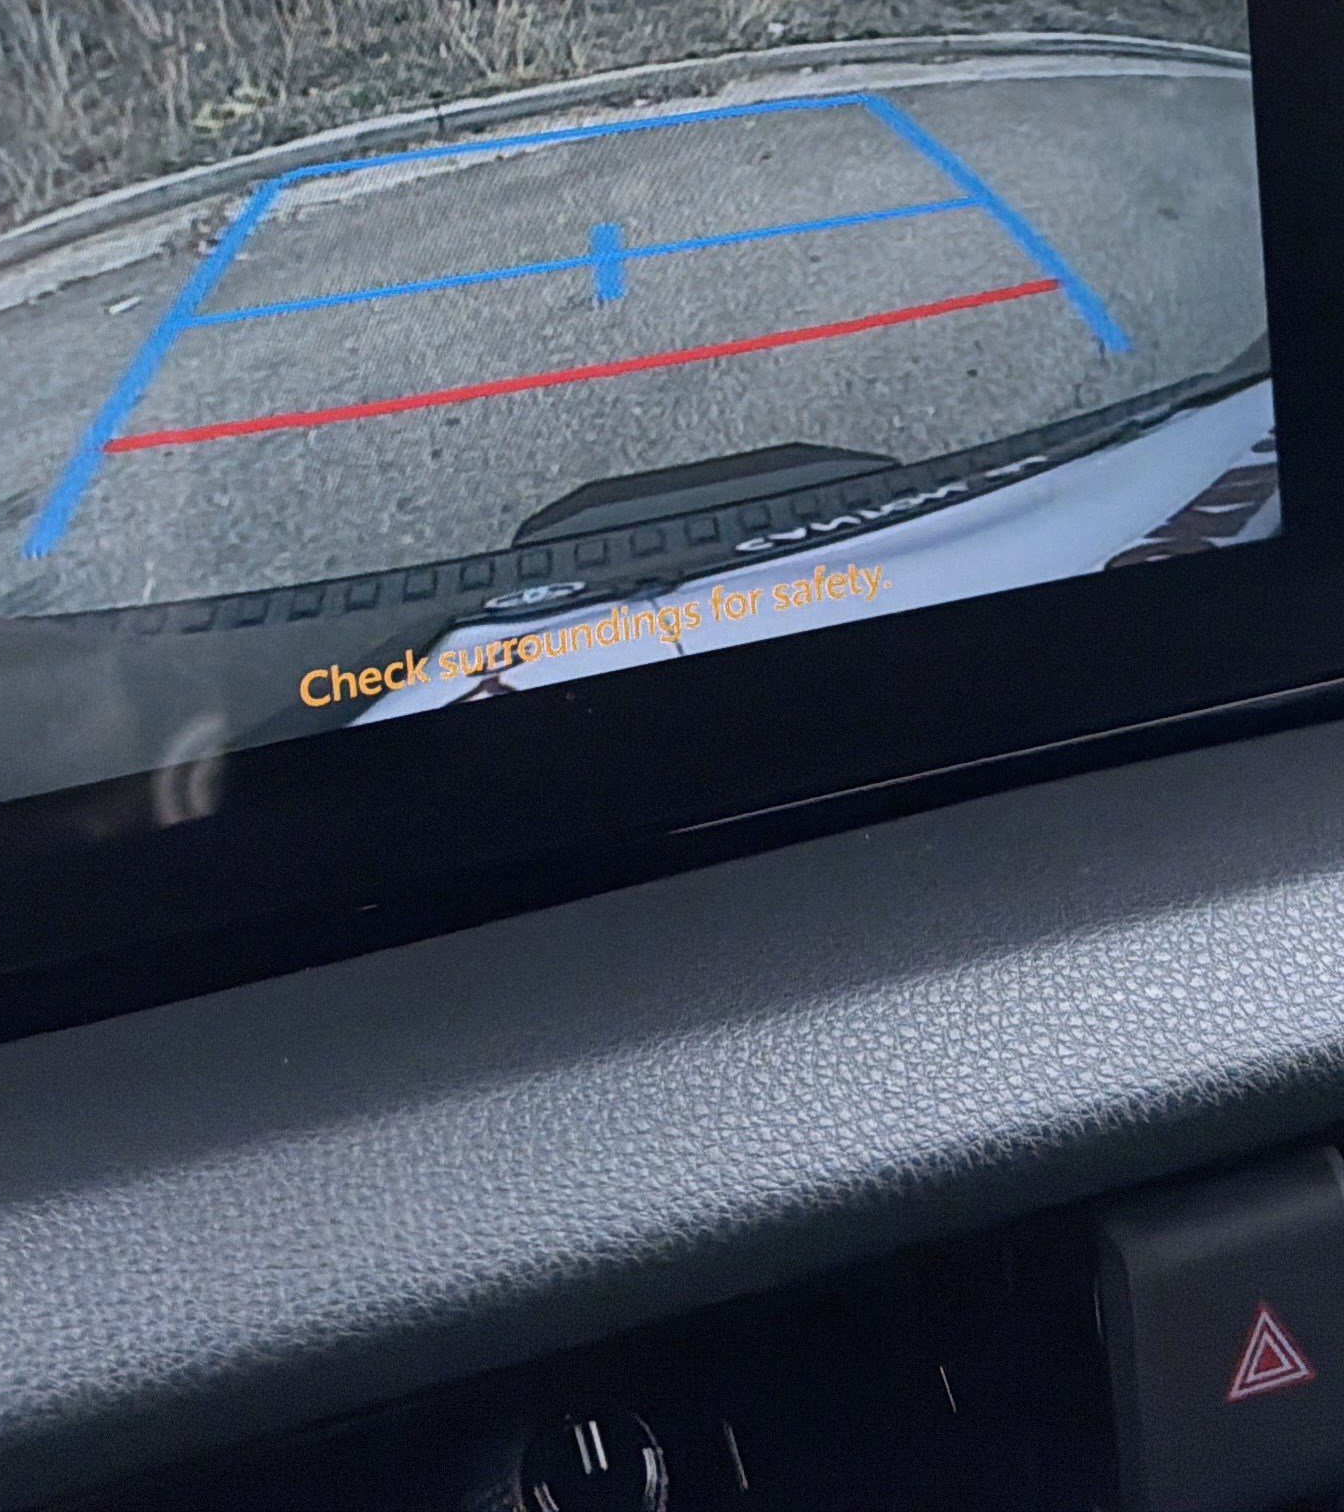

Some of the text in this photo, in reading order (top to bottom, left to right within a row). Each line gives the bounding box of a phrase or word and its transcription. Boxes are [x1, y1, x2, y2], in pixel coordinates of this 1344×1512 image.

[299, 564, 893, 707] Check surroundings for safety.
